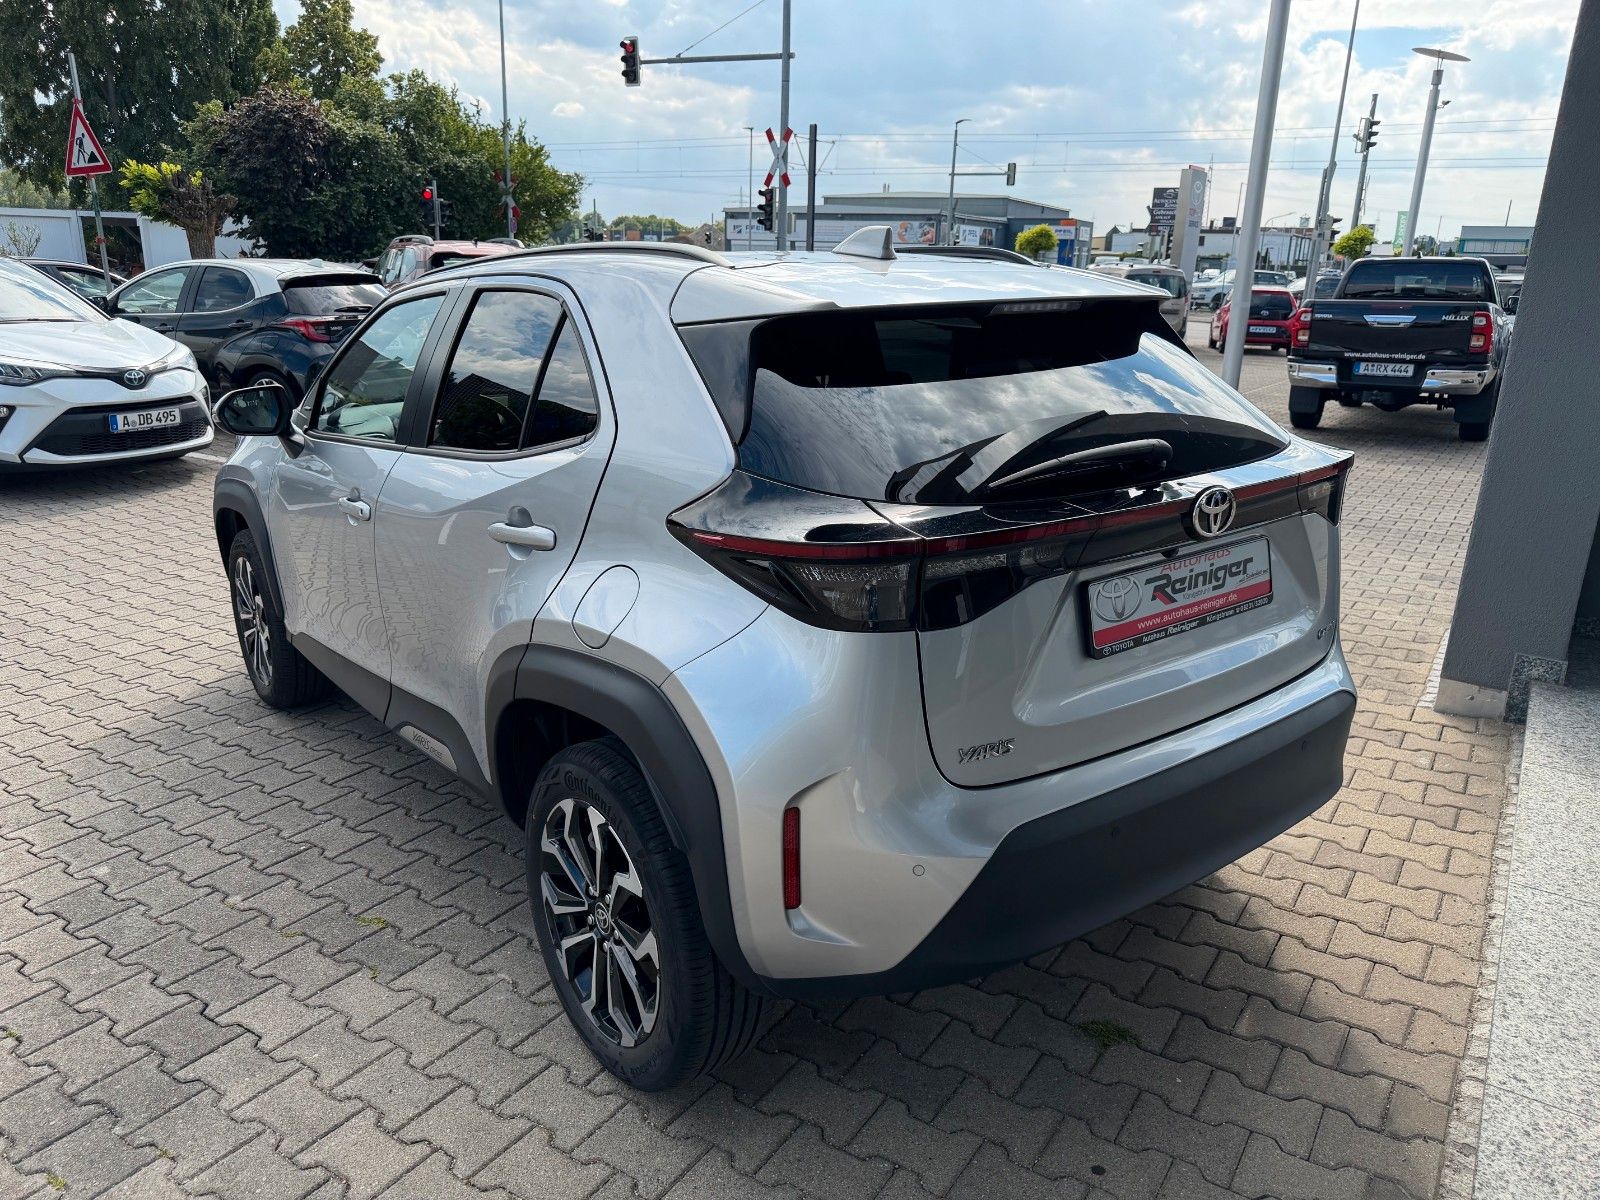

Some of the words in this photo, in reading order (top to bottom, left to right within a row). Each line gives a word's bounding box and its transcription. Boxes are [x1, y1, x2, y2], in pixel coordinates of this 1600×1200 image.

[1344, 351, 1426, 361] www.autohaus-reiniger.de
[1363, 364, 1370, 373] A
[1376, 364, 1390, 374] RX
[1391, 364, 1409, 375] 444
[122, 415, 131, 428] A
[137, 413, 153, 426] DB
[155, 410, 176, 424] 495
[1145, 557, 1254, 605] Reiniger
[1137, 592, 1239, 631] www.autohaus-reiniger.de
[1112, 640, 1134, 653] TOYOTA
[1167, 620, 1200, 636] Reiniger
[958, 737, 1016, 765] YARIS
